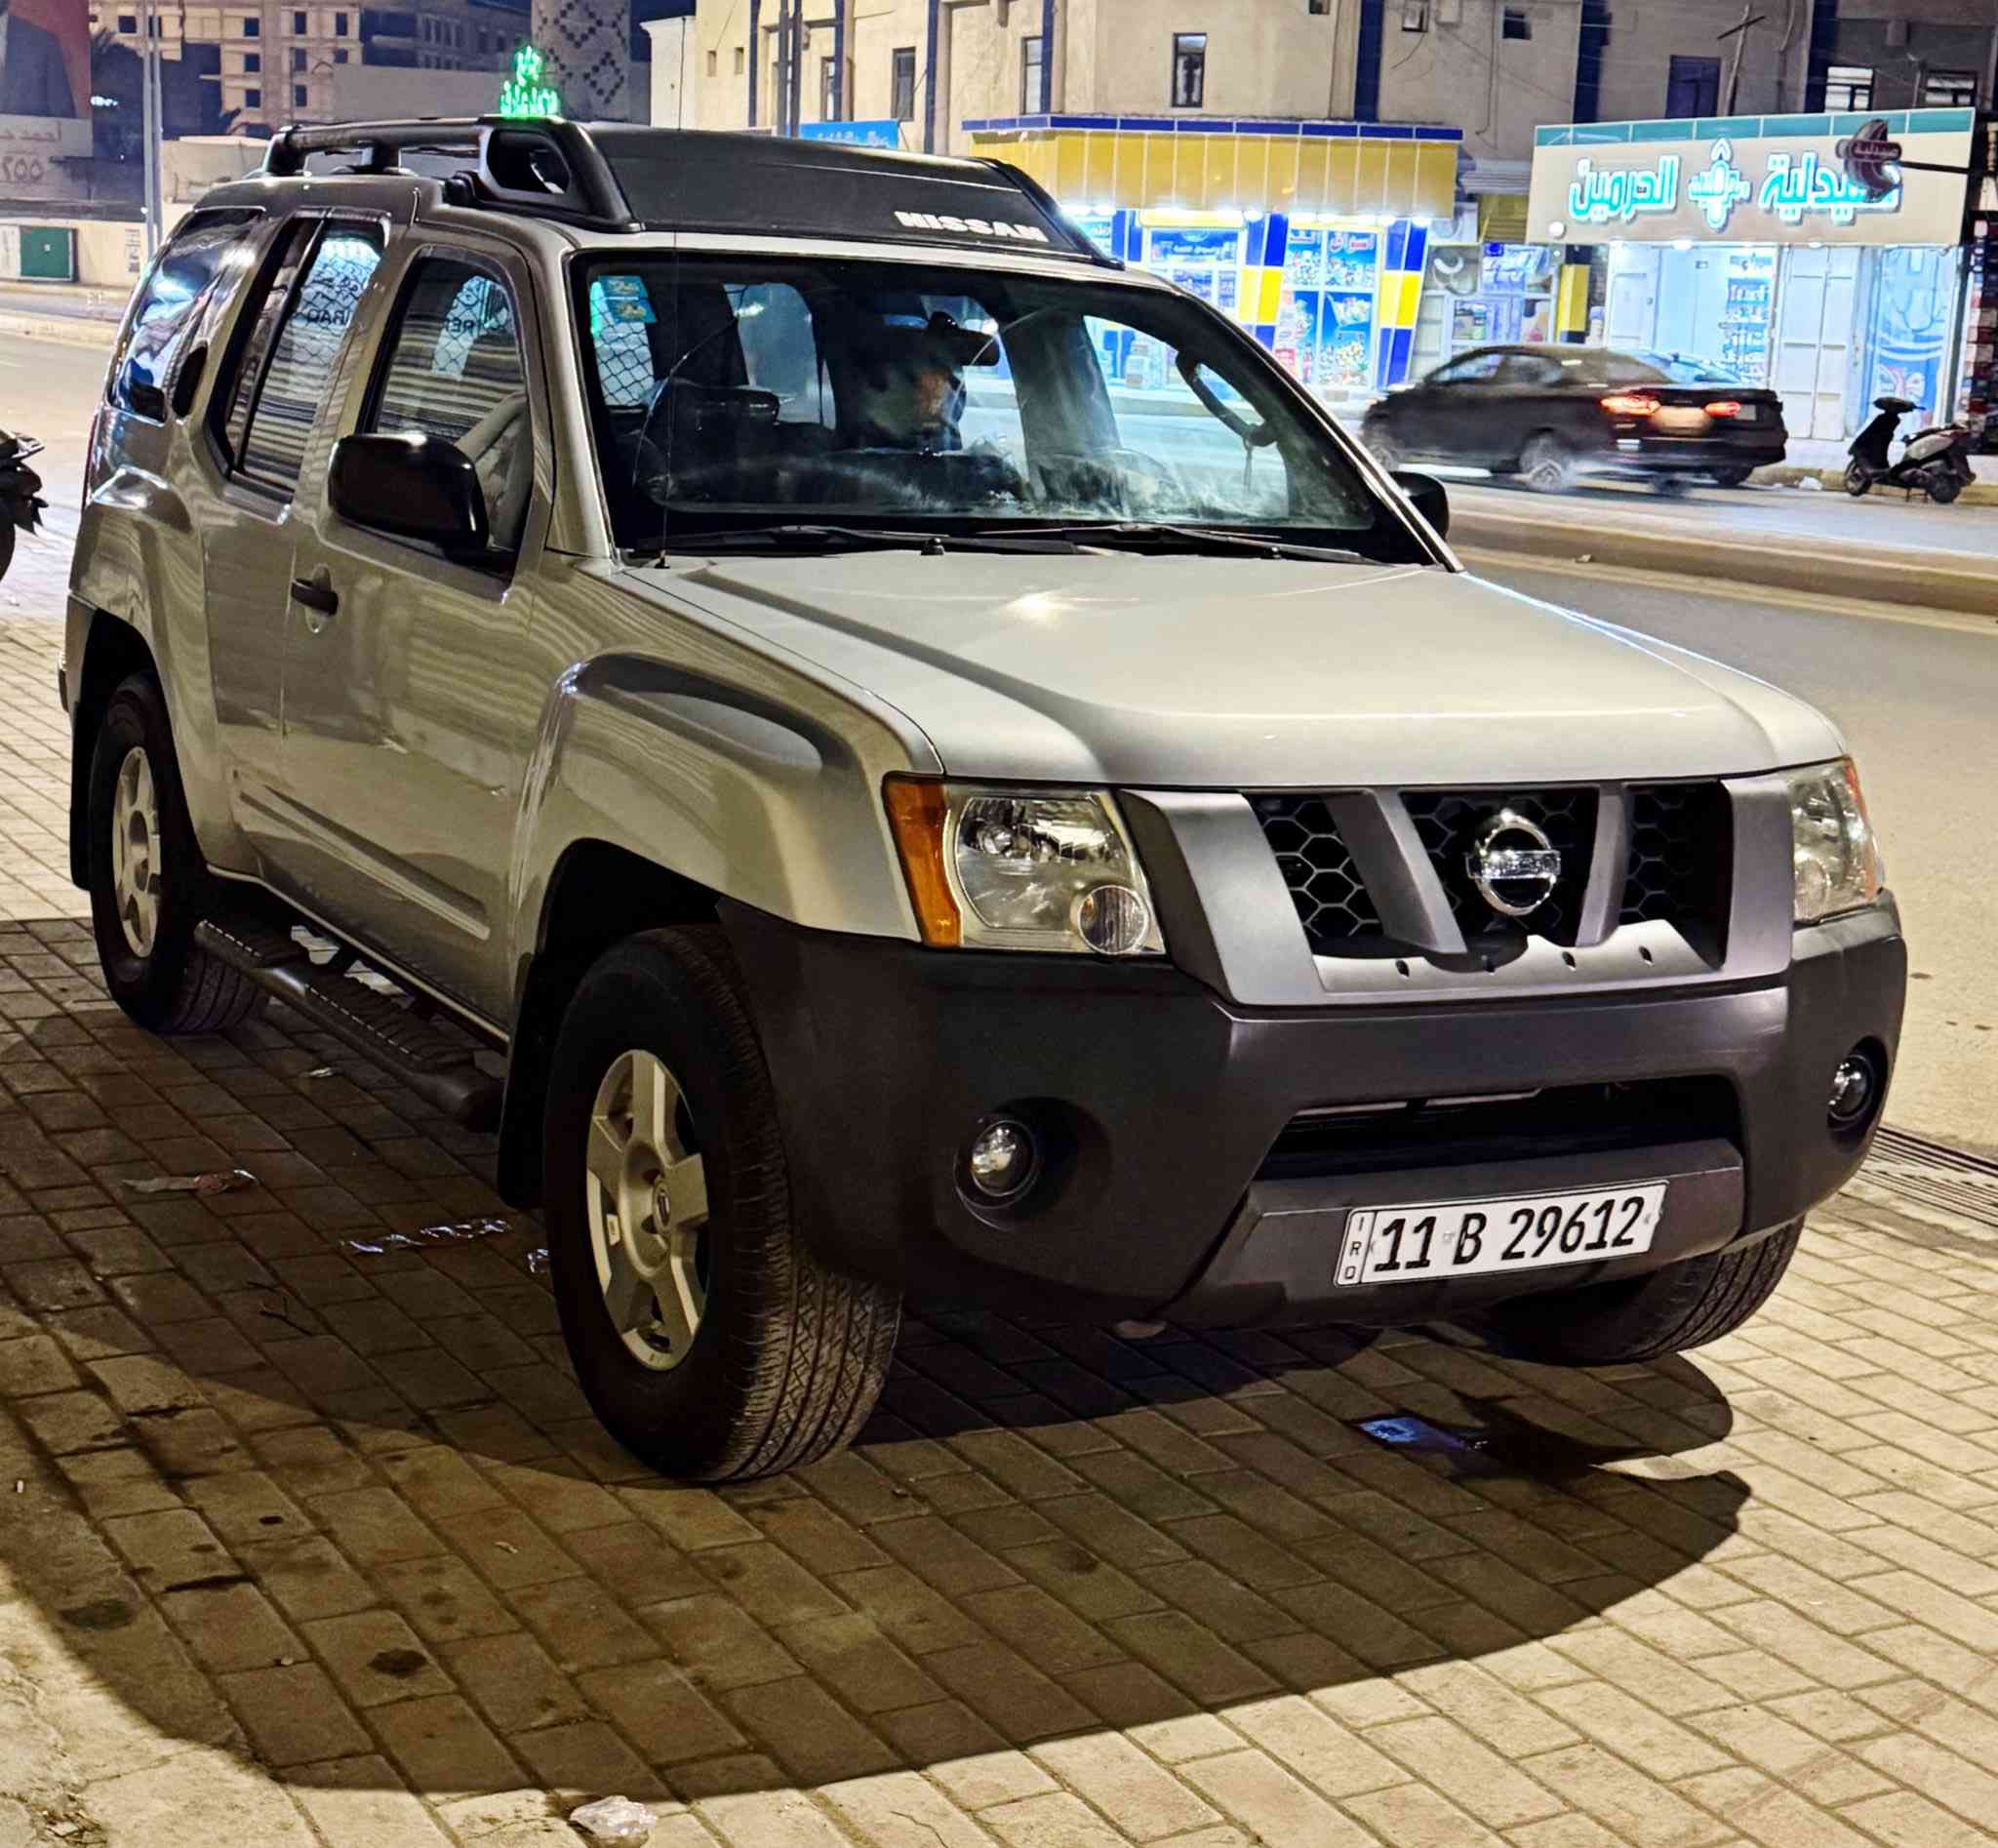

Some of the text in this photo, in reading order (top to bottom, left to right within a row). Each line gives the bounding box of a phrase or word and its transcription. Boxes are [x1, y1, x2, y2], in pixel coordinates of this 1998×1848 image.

[1569, 154, 1681, 221] الحرمين
[894, 211, 1050, 243] NISSAN
[1374, 1196, 1645, 1272] 11 B 29612
